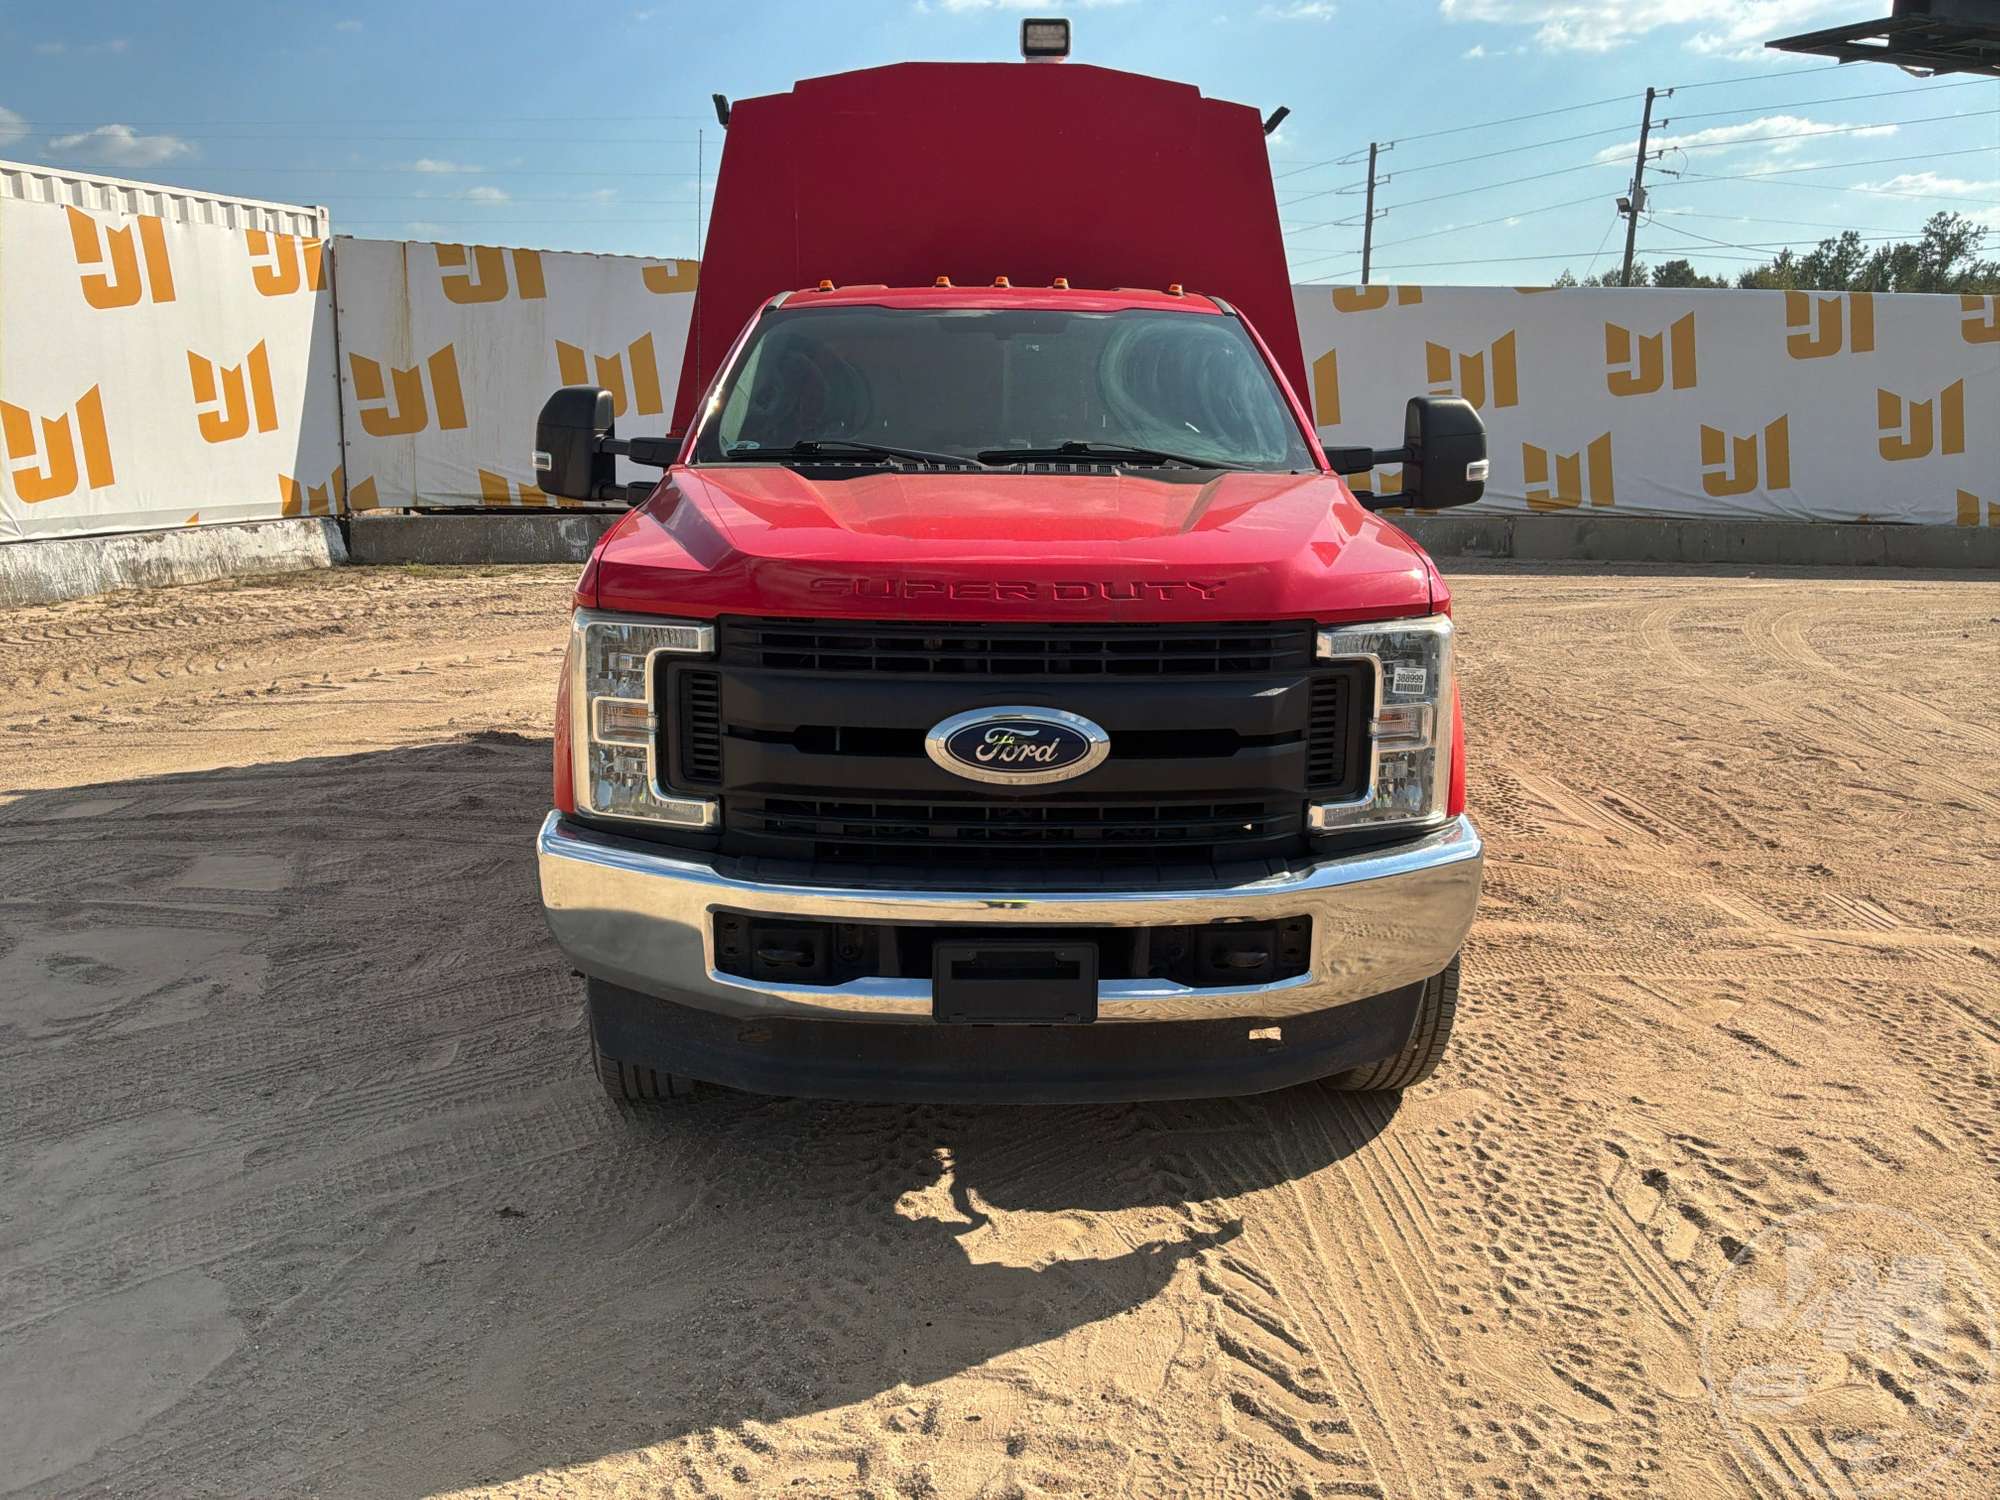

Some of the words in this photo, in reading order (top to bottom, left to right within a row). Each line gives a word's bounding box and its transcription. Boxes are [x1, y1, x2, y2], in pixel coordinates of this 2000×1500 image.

[809, 577, 1040, 601] SUPER
[1053, 580, 1227, 601] DUTY
[975, 727, 1060, 762] Ford
